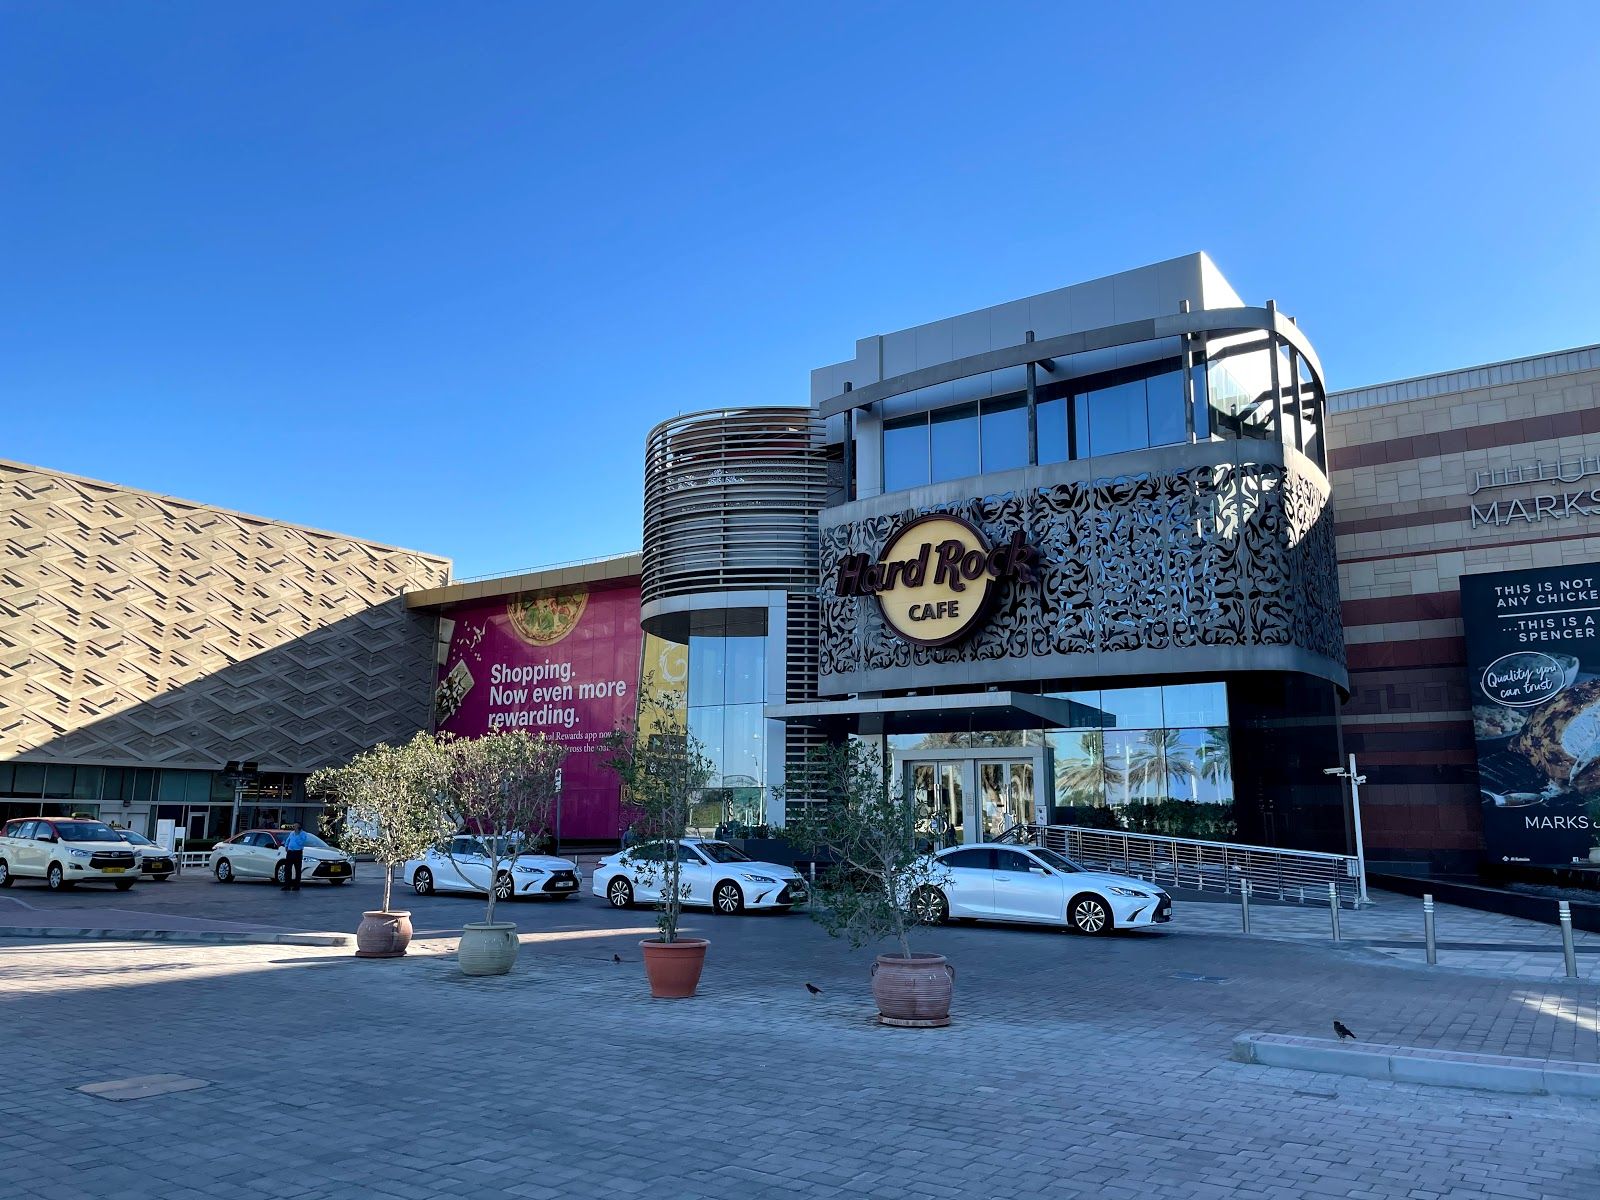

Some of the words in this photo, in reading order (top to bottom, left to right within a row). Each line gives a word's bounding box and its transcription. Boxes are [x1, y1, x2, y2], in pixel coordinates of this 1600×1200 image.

[835, 543, 931, 597] Hard
[933, 530, 1039, 592] Rock
[1495, 584, 1531, 596] THIS
[1538, 582, 1553, 592] IS
[1560, 578, 1593, 590] NOT
[908, 600, 959, 621] CAFE
[1497, 596, 1529, 608] ANY
[1562, 617, 1577, 627] IS
[1584, 615, 1595, 625] A
[1519, 628, 1596, 642] SPENCER
[490, 659, 576, 686] Shopping.
[1487, 668, 1533, 688] Quality
[1536, 665, 1557, 681] you
[489, 686, 527, 706] Now
[532, 685, 573, 703] even
[579, 680, 627, 699] more
[1500, 687, 1521, 699] can
[1523, 678, 1553, 694] trust
[488, 704, 580, 728] rewarding.
[555, 730, 584, 741] Rewards
[585, 733, 598, 742] app
[584, 743, 595, 752] the
[1525, 815, 1589, 829] MARKS
